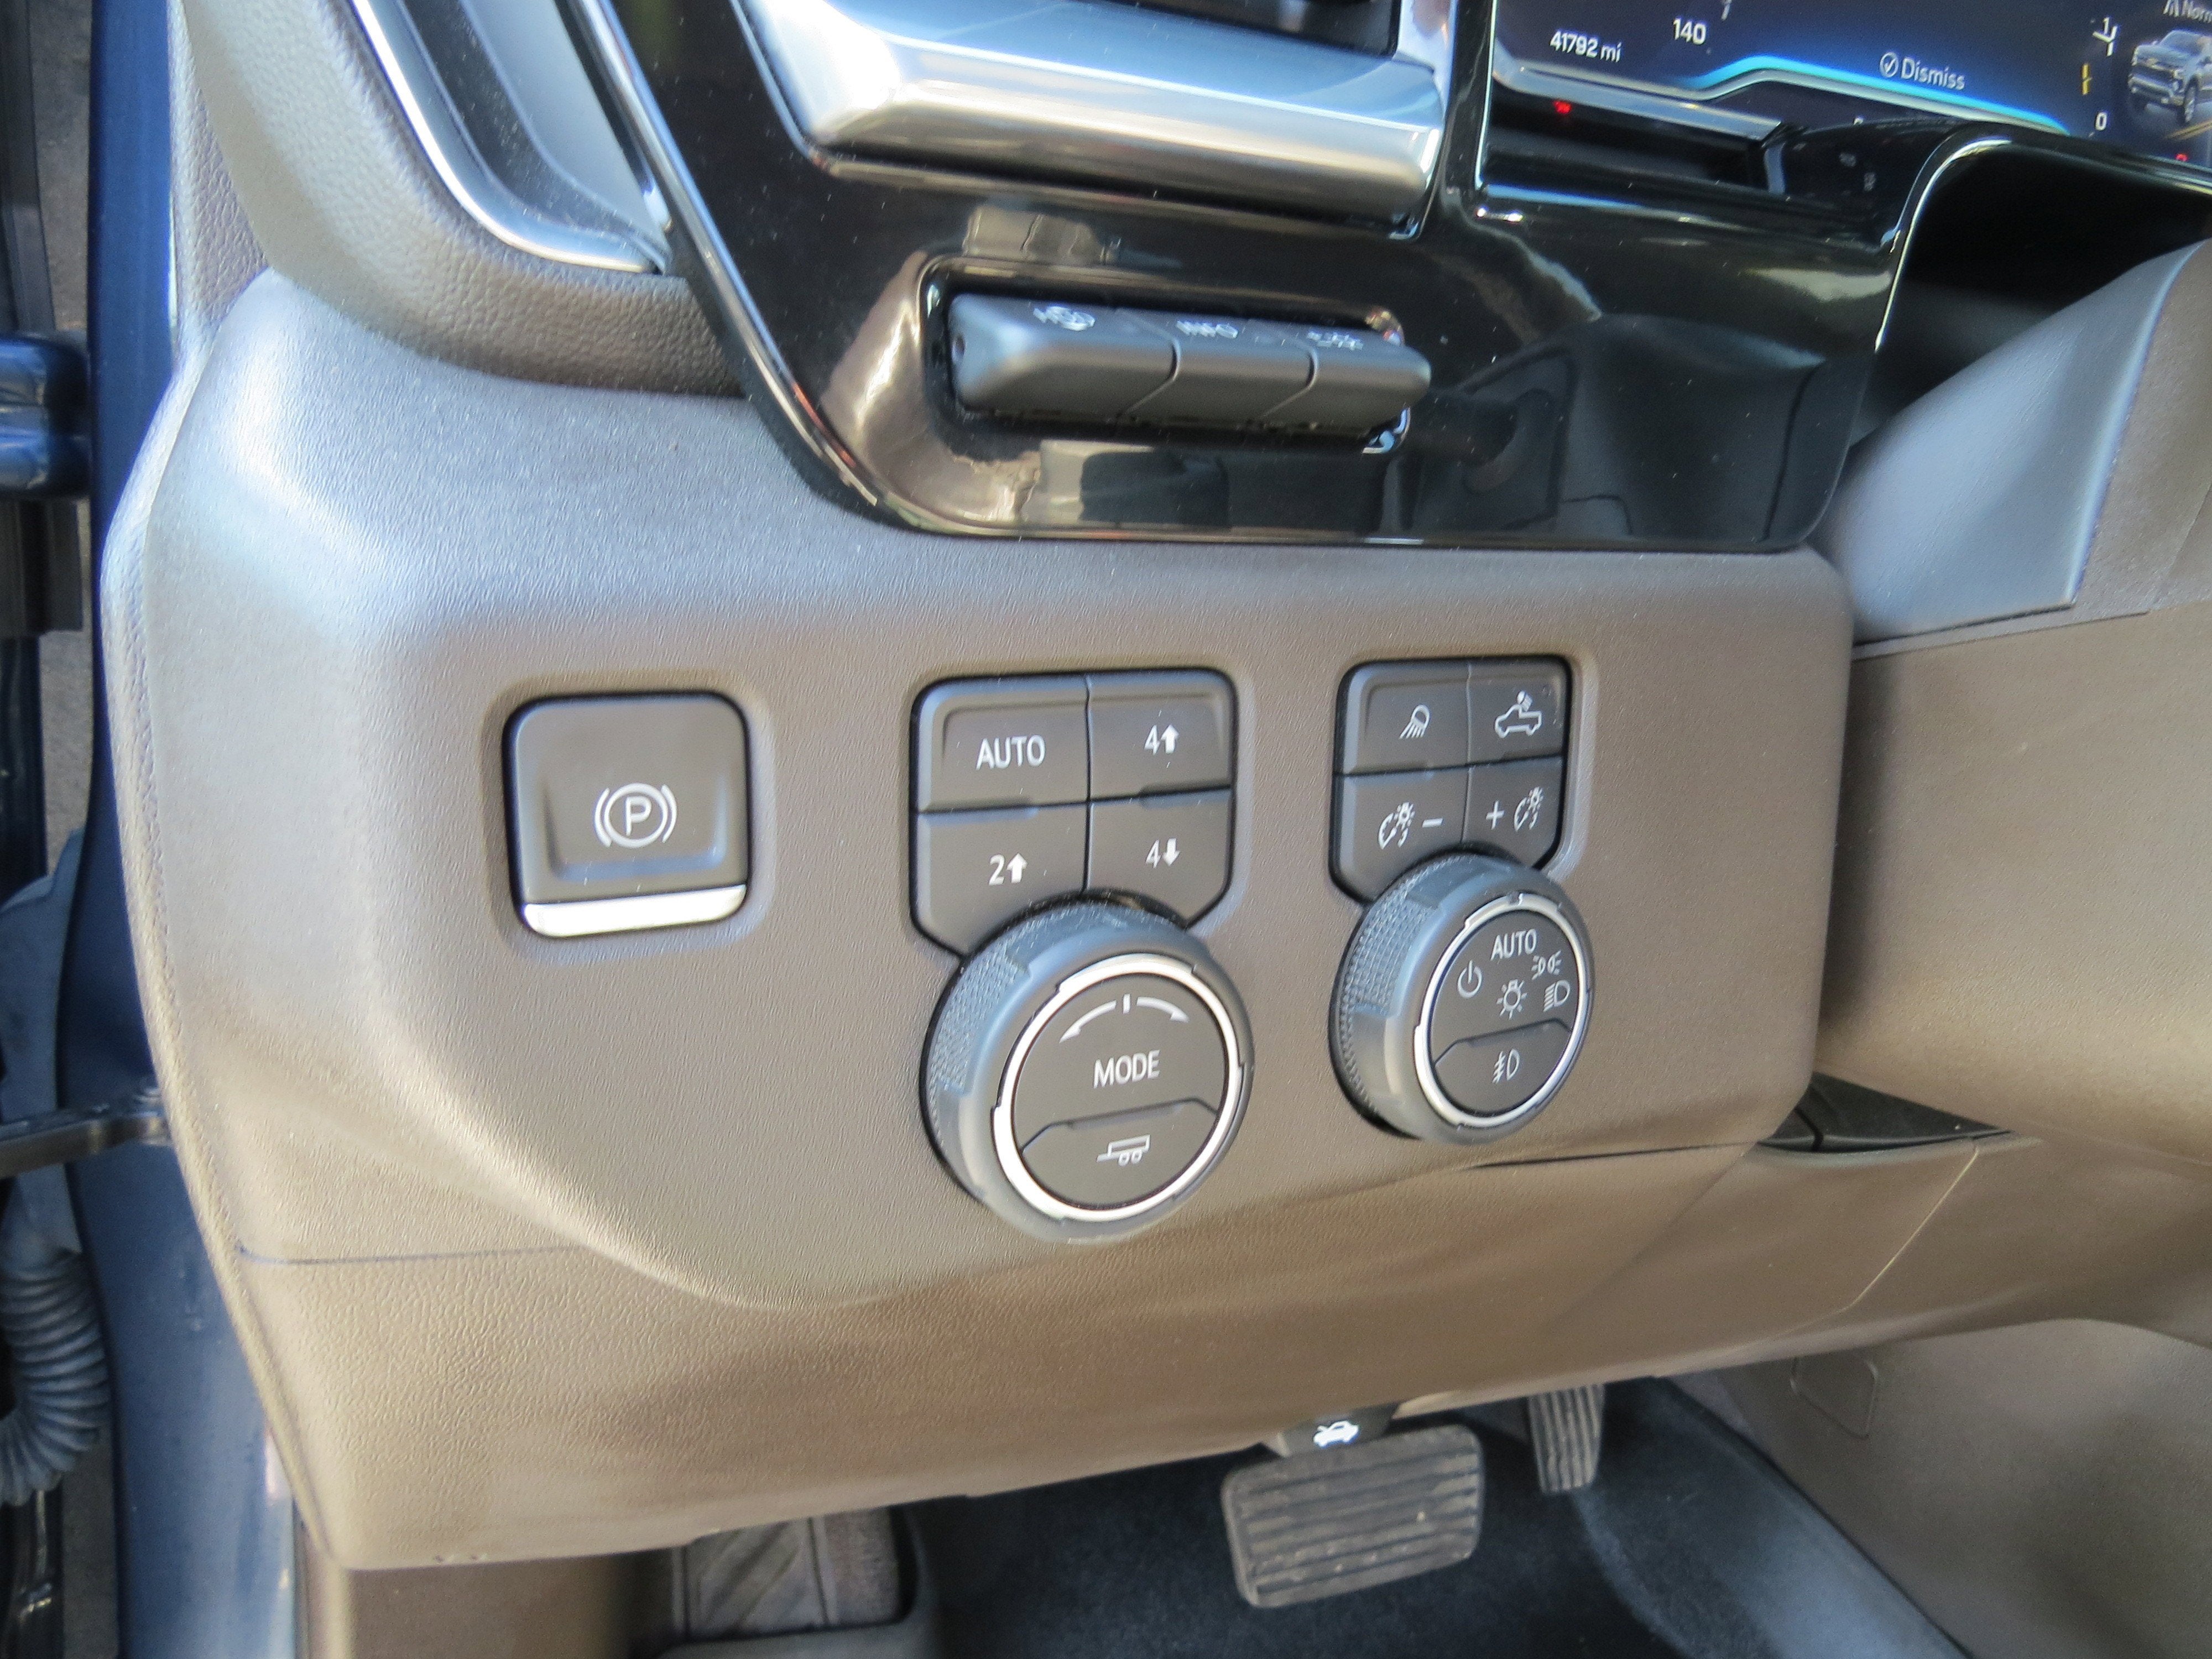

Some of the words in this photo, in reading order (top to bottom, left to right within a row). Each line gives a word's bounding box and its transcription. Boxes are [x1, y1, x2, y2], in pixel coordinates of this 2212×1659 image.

[1550, 30, 1598, 58] 41792
[1600, 41, 1622, 63] mi
[1673, 17, 1707, 45] 140
[1901, 56, 1965, 91] Dismiss
[2095, 112, 2108, 131] 0
[975, 734, 1046, 770] AUTO
[1144, 724, 1161, 755] 4
[625, 795, 652, 836] P
[988, 854, 1004, 885] 2
[1145, 839, 1161, 868] 4
[1490, 928, 1537, 961] AUTO
[1093, 1049, 1161, 1089] MODE
